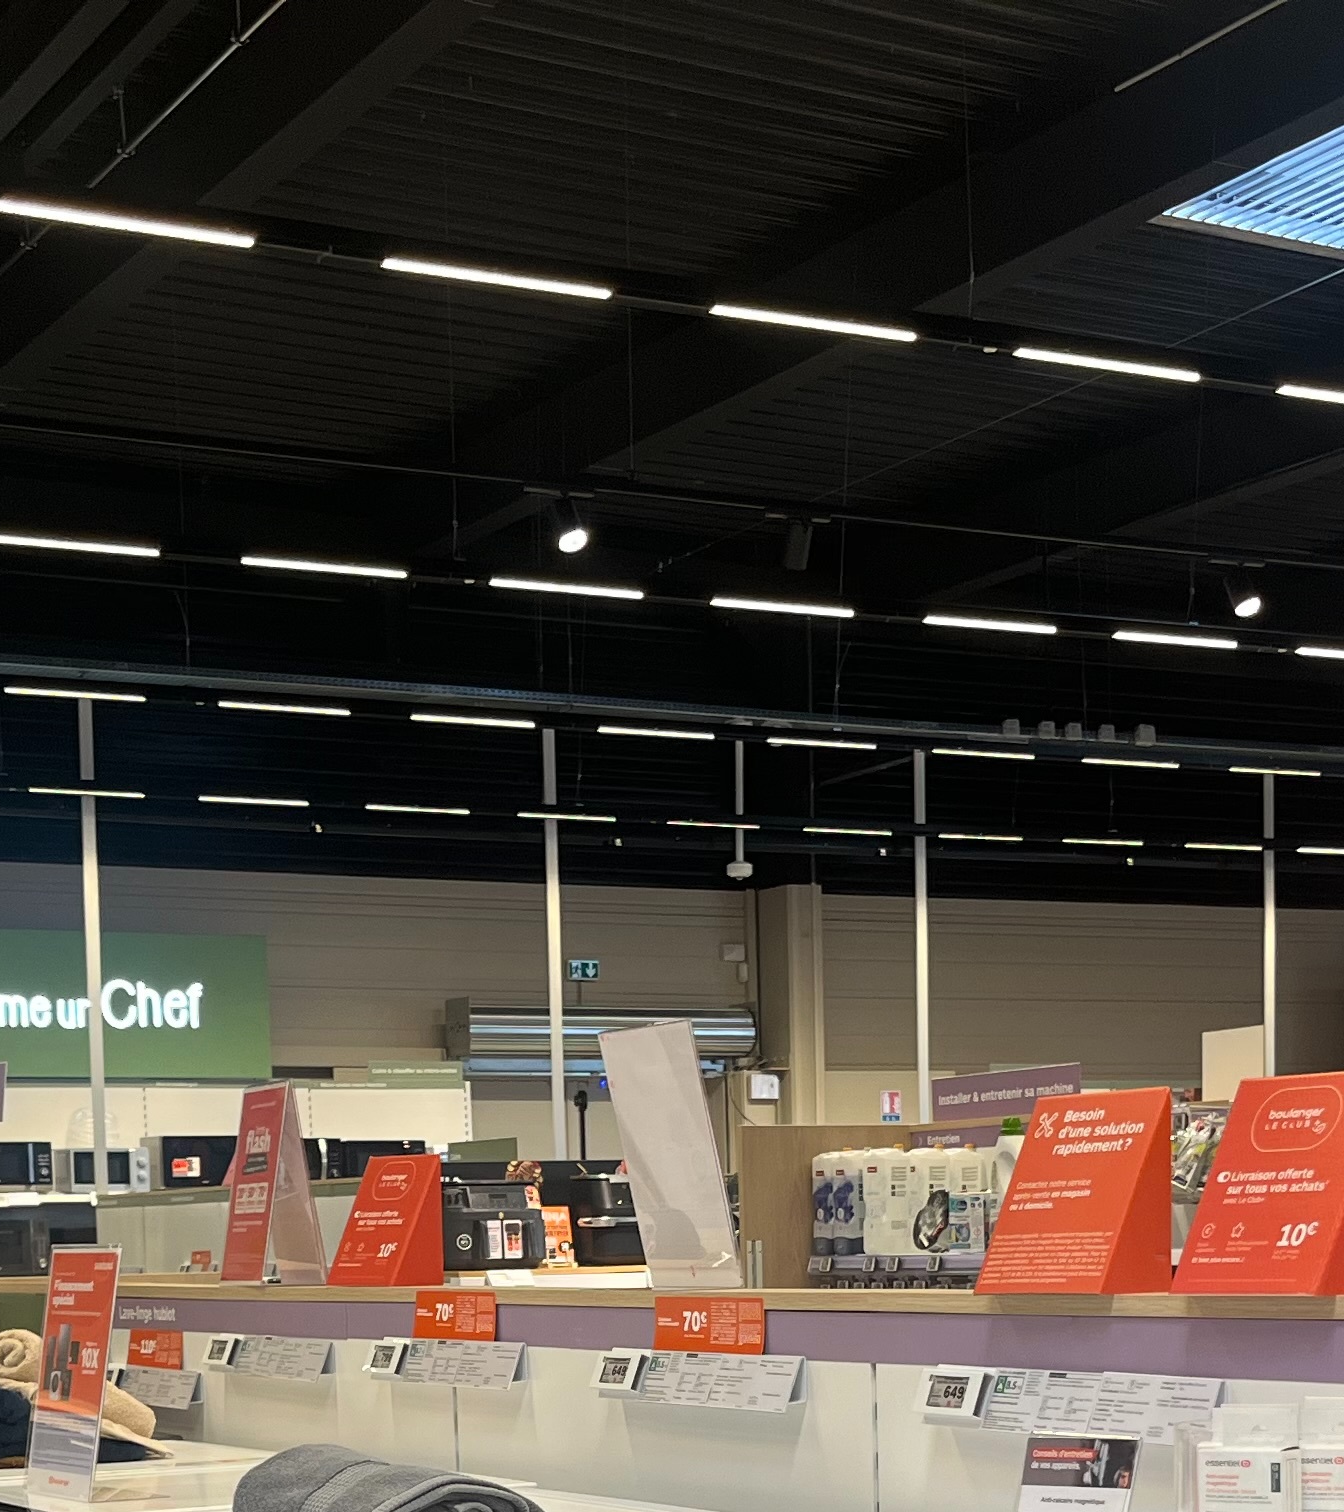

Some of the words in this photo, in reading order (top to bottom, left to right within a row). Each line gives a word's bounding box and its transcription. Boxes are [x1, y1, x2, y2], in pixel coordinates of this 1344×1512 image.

[100, 978, 204, 1029] Chef
[938, 1092, 971, 1106] Installer
[972, 1091, 979, 1103] &
[980, 1088, 1022, 1102] entretenir
[1024, 1088, 1034, 1098] sa
[1036, 1082, 1073, 1097] machine
[1063, 1108, 1105, 1123] Besoin
[1268, 1107, 1325, 1121] boulanger
[1058, 1125, 1092, 1139] d'une
[1093, 1121, 1145, 1137] solution
[926, 1133, 961, 1146] Entretien
[1231, 1170, 1277, 1183] Livraison
[1277, 1167, 1314, 1181] offerte
[1226, 1185, 1244, 1195] sur
[1245, 1182, 1268, 1194] tous
[1269, 1184, 1288, 1193] vos
[943, 1385, 964, 1400] 649
